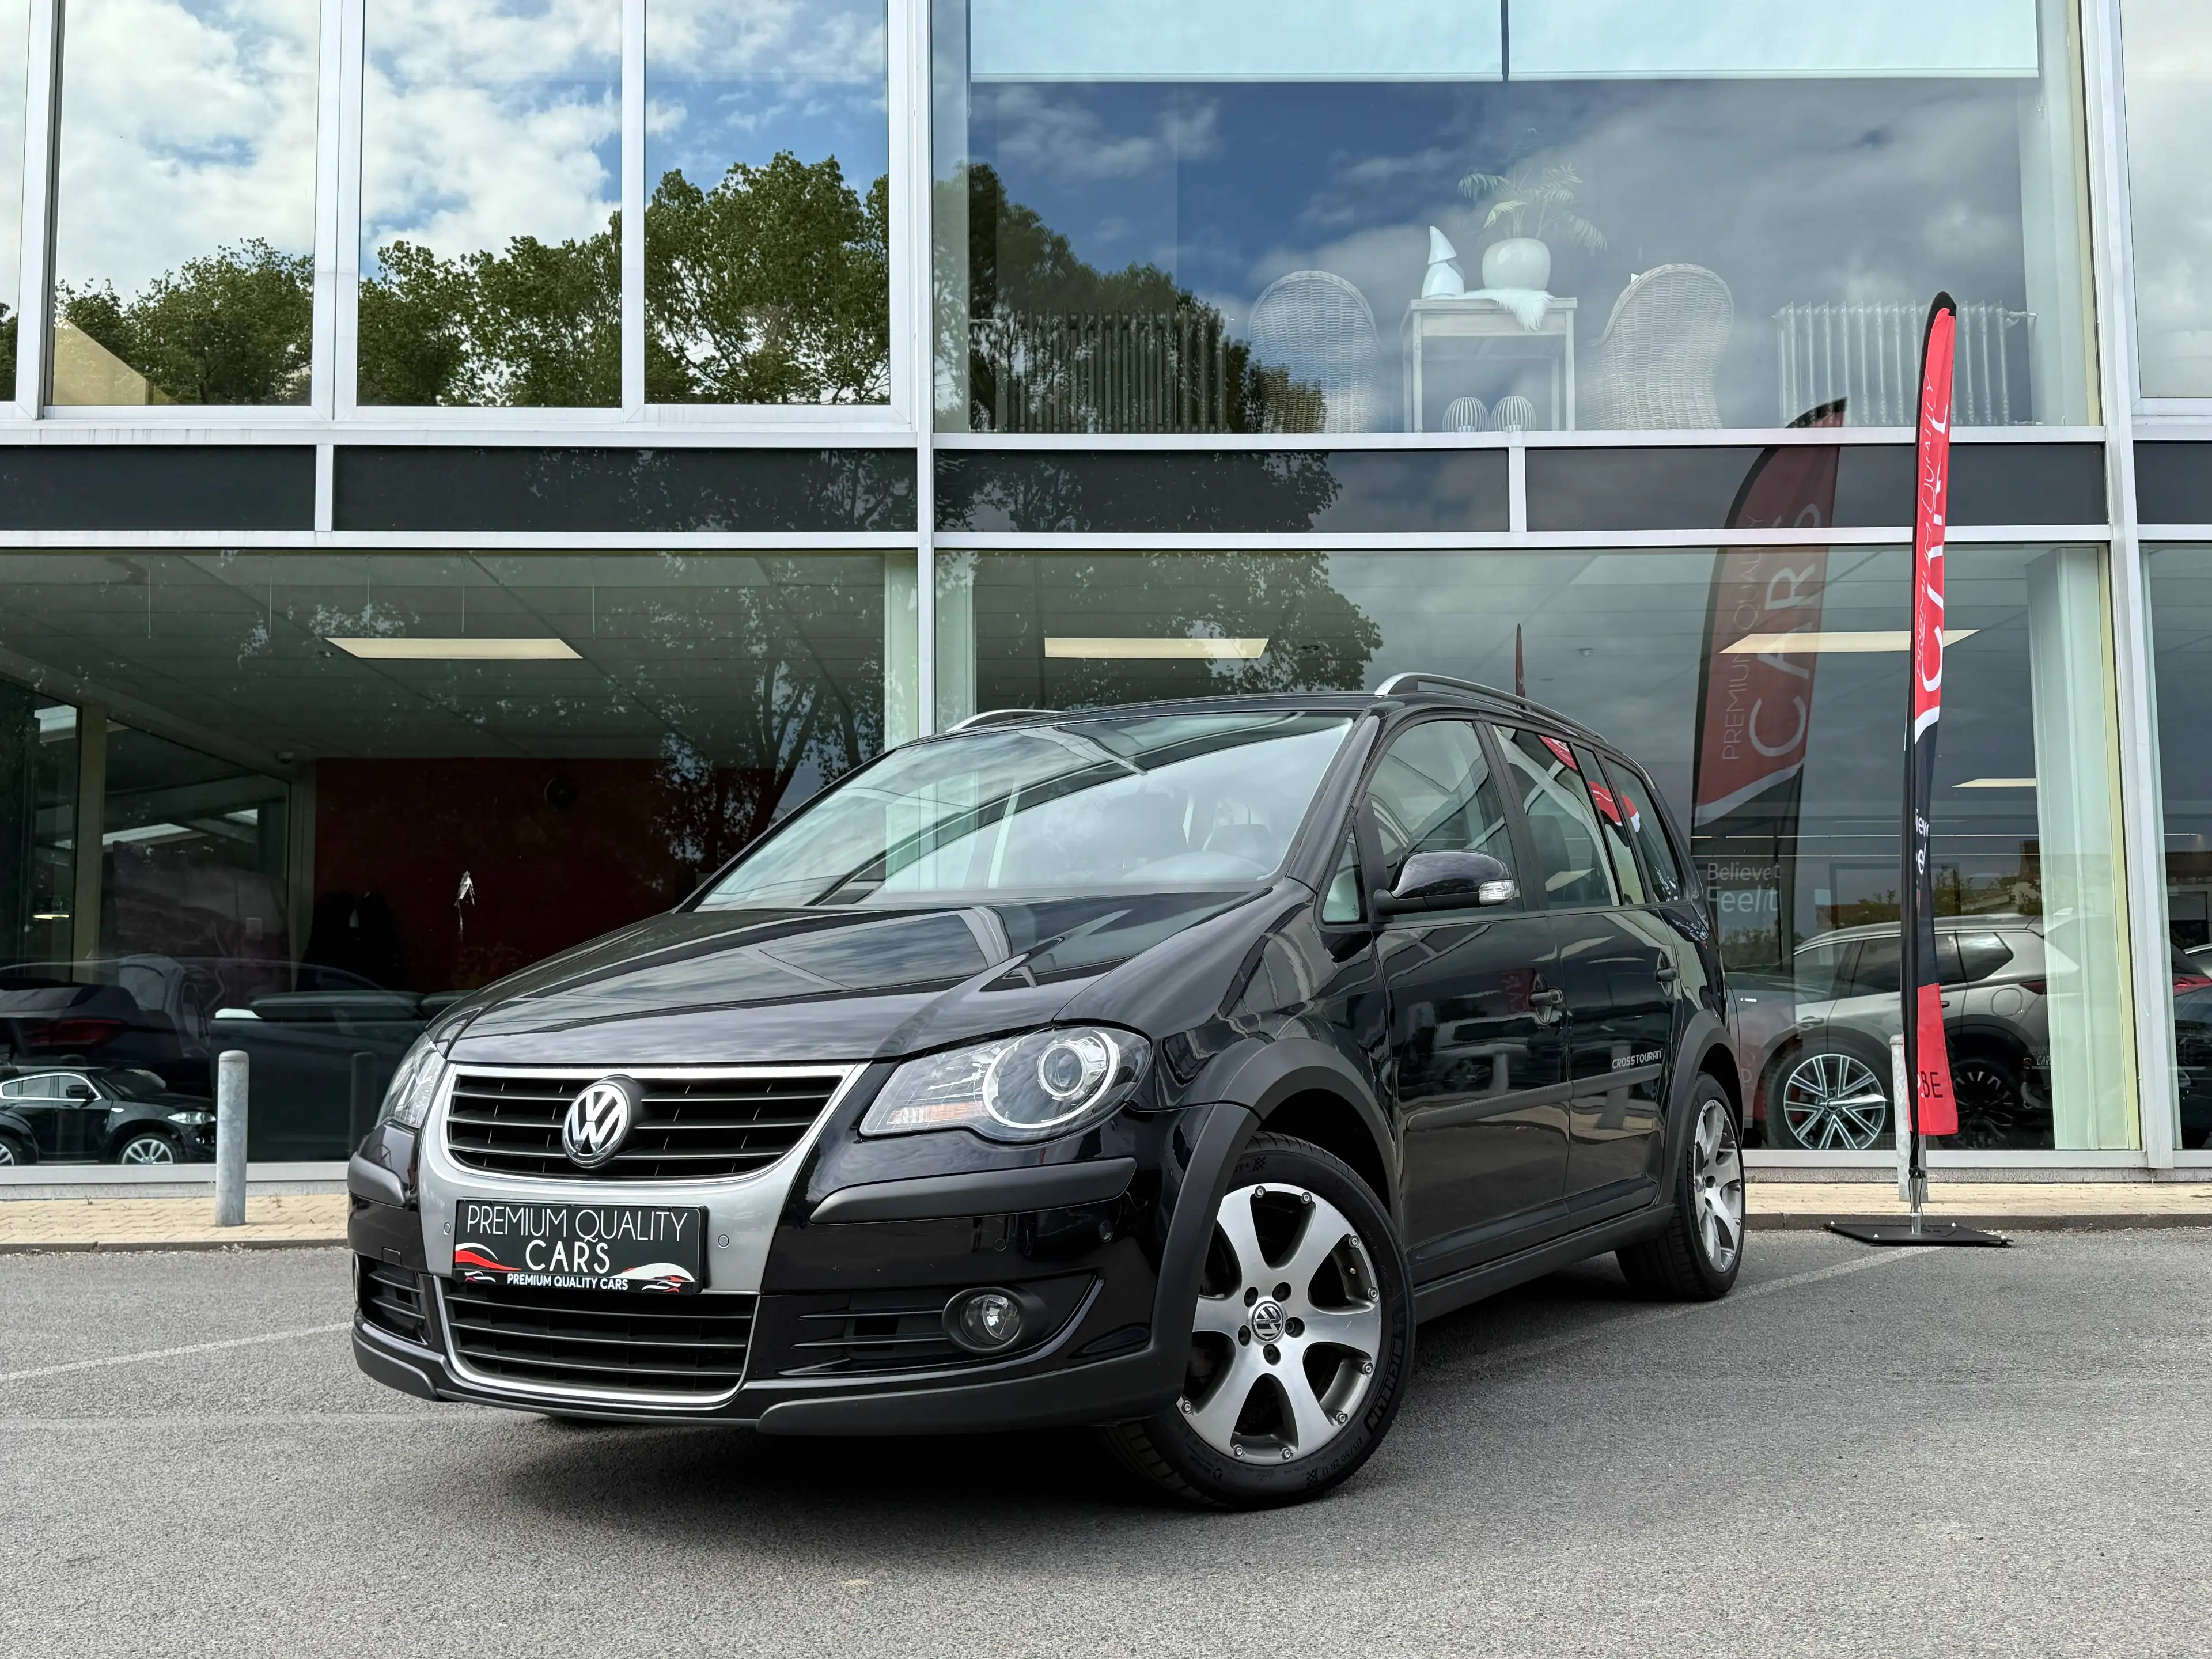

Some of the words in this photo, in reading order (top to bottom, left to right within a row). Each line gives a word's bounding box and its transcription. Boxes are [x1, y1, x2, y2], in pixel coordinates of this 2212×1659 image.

[2037, 1055, 2051, 1066] CAR
[467, 1205, 567, 1238] PREMIUM
[575, 1209, 688, 1243] QUALITY
[525, 1239, 611, 1274] CARS
[507, 1273, 552, 1287] PREMIUM
[554, 1275, 598, 1290] QUALITY
[599, 1278, 629, 1290] CARS
[1368, 1338, 1403, 1429] MICHELIN
